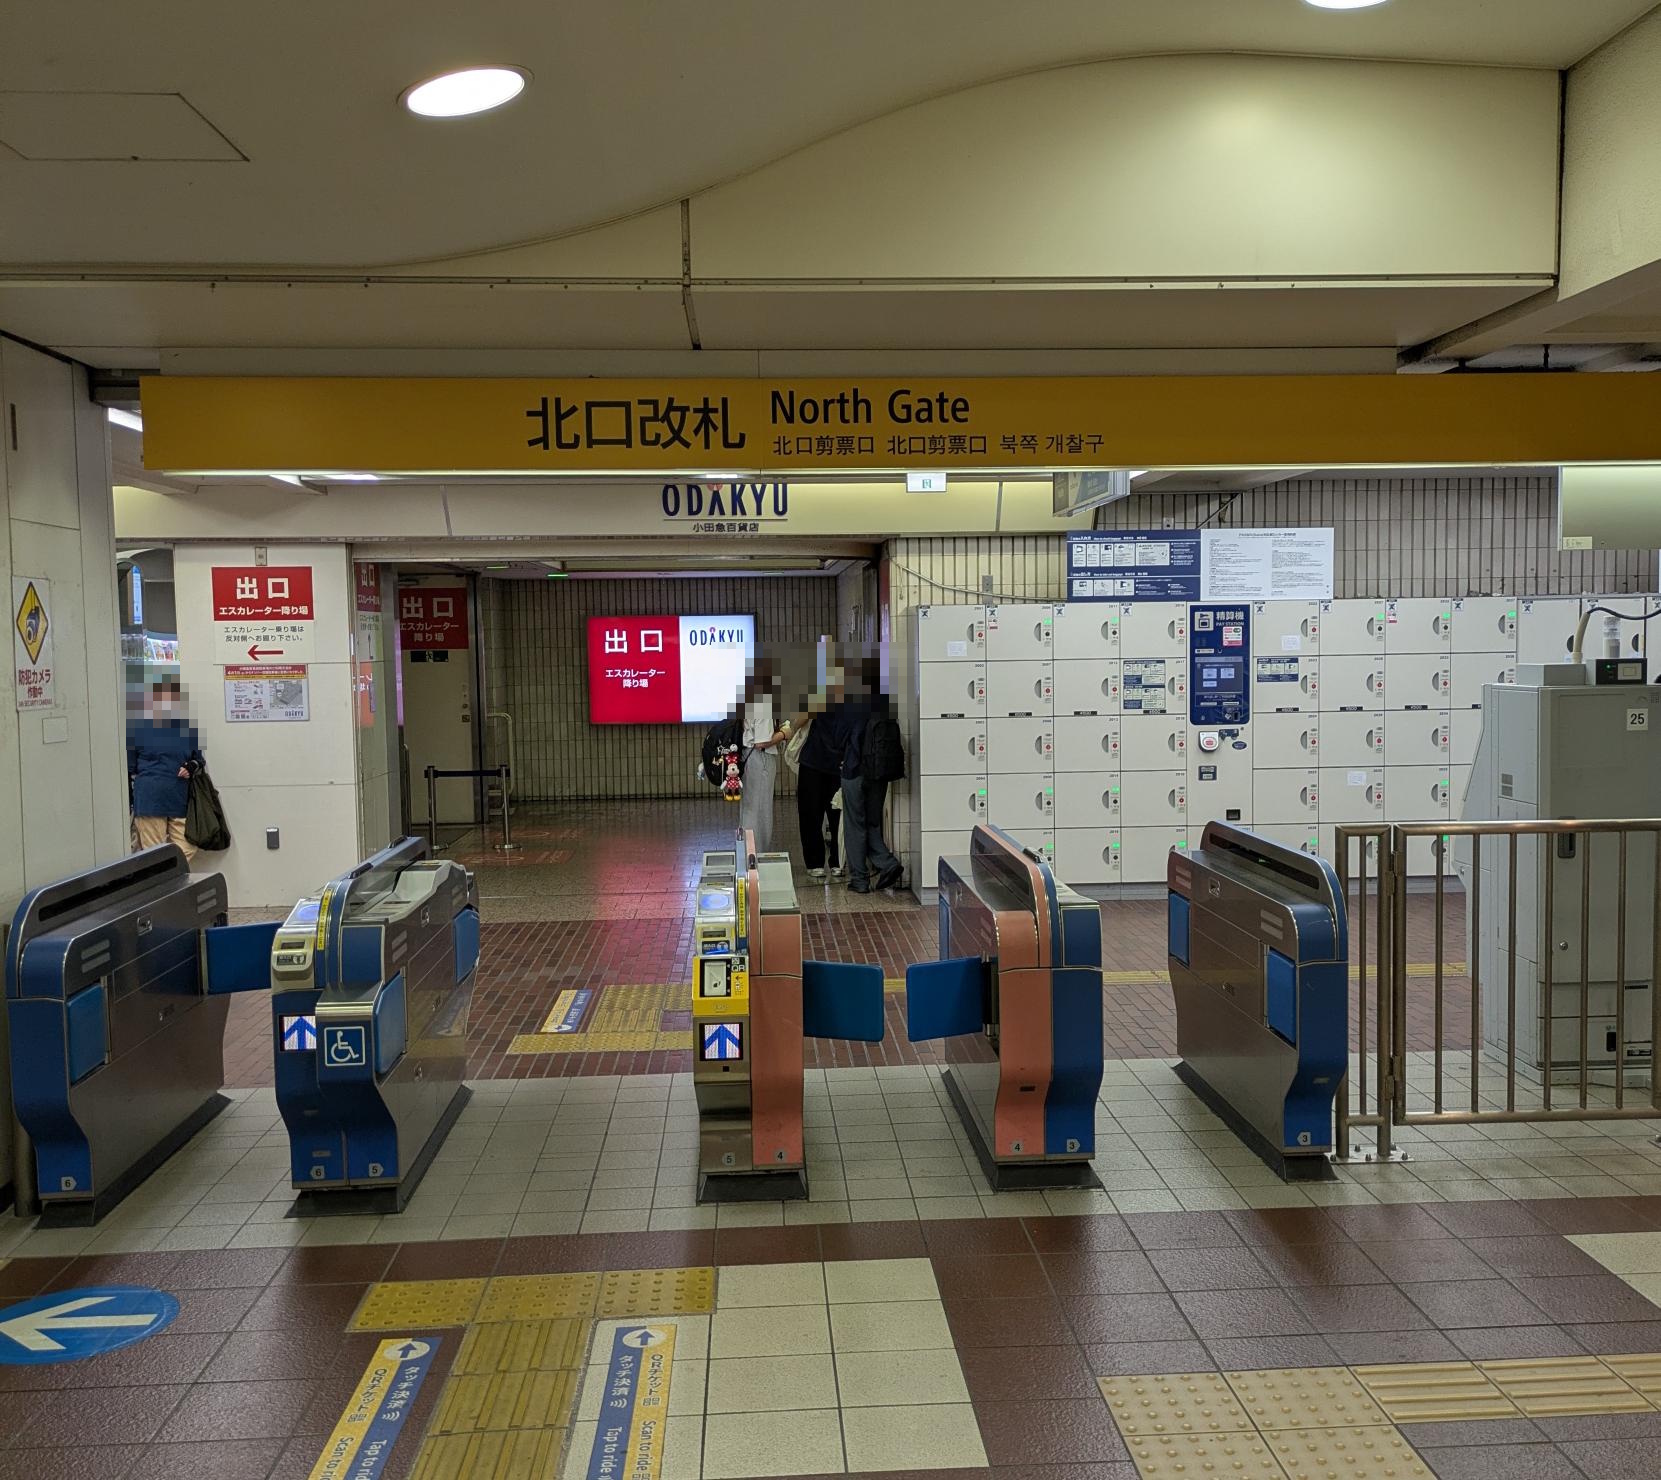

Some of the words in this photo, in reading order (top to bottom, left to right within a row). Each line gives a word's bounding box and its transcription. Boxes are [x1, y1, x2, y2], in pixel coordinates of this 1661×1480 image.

[771, 388, 872, 424] North
[888, 388, 970, 424] Gate
[526, 396, 746, 451] 北口改札
[772, 434, 875, 457] 北口剪票口
[886, 434, 988, 457] 北口剪票口
[999, 434, 1039, 456] 북쪽
[1044, 433, 1105, 456] 개찰구
[662, 482, 788, 516] ODAKYU
[692, 522, 760, 533] 小田急百貨店
[235, 577, 290, 600] 出口
[218, 604, 309, 616] エスカレーター降り場
[402, 595, 454, 619] 出口
[223, 624, 305, 634] エスカレーター乗り場は
[399, 622, 460, 631] エスカレーター
[604, 628, 663, 654] 出口
[18, 668, 52, 686] 防犯カメラ
[604, 668, 666, 678] エスカレーター
[622, 678, 649, 689] 降り場
[1629, 713, 1645, 725] 25
[1069, 1141, 1075, 1150] 3
[1302, 1134, 1308, 1143] 3
[1014, 1143, 1021, 1152] 4
[726, 1154, 733, 1163] 5
[777, 1151, 784, 1160] 4
[315, 1168, 322, 1177] 6
[372, 1165, 378, 1174] 5
[64, 1179, 71, 1188] 6
[611, 1354, 635, 1397] タッチ決済
[647, 1354, 664, 1396] QRチケット
[357, 1368, 388, 1412] QRチケット
[386, 1366, 420, 1410] タッチ決済
[602, 1427, 623, 1443] Tap
[640, 1420, 657, 1441] Scan
[332, 1435, 354, 1458] Scan
[364, 1439, 388, 1456] Tap
[603, 1443, 617, 1453] to
[639, 1441, 653, 1452] to
[326, 1458, 344, 1469] to
[361, 1456, 379, 1468] to
[600, 1454, 618, 1475] ride
[636, 1452, 652, 1472] ride
